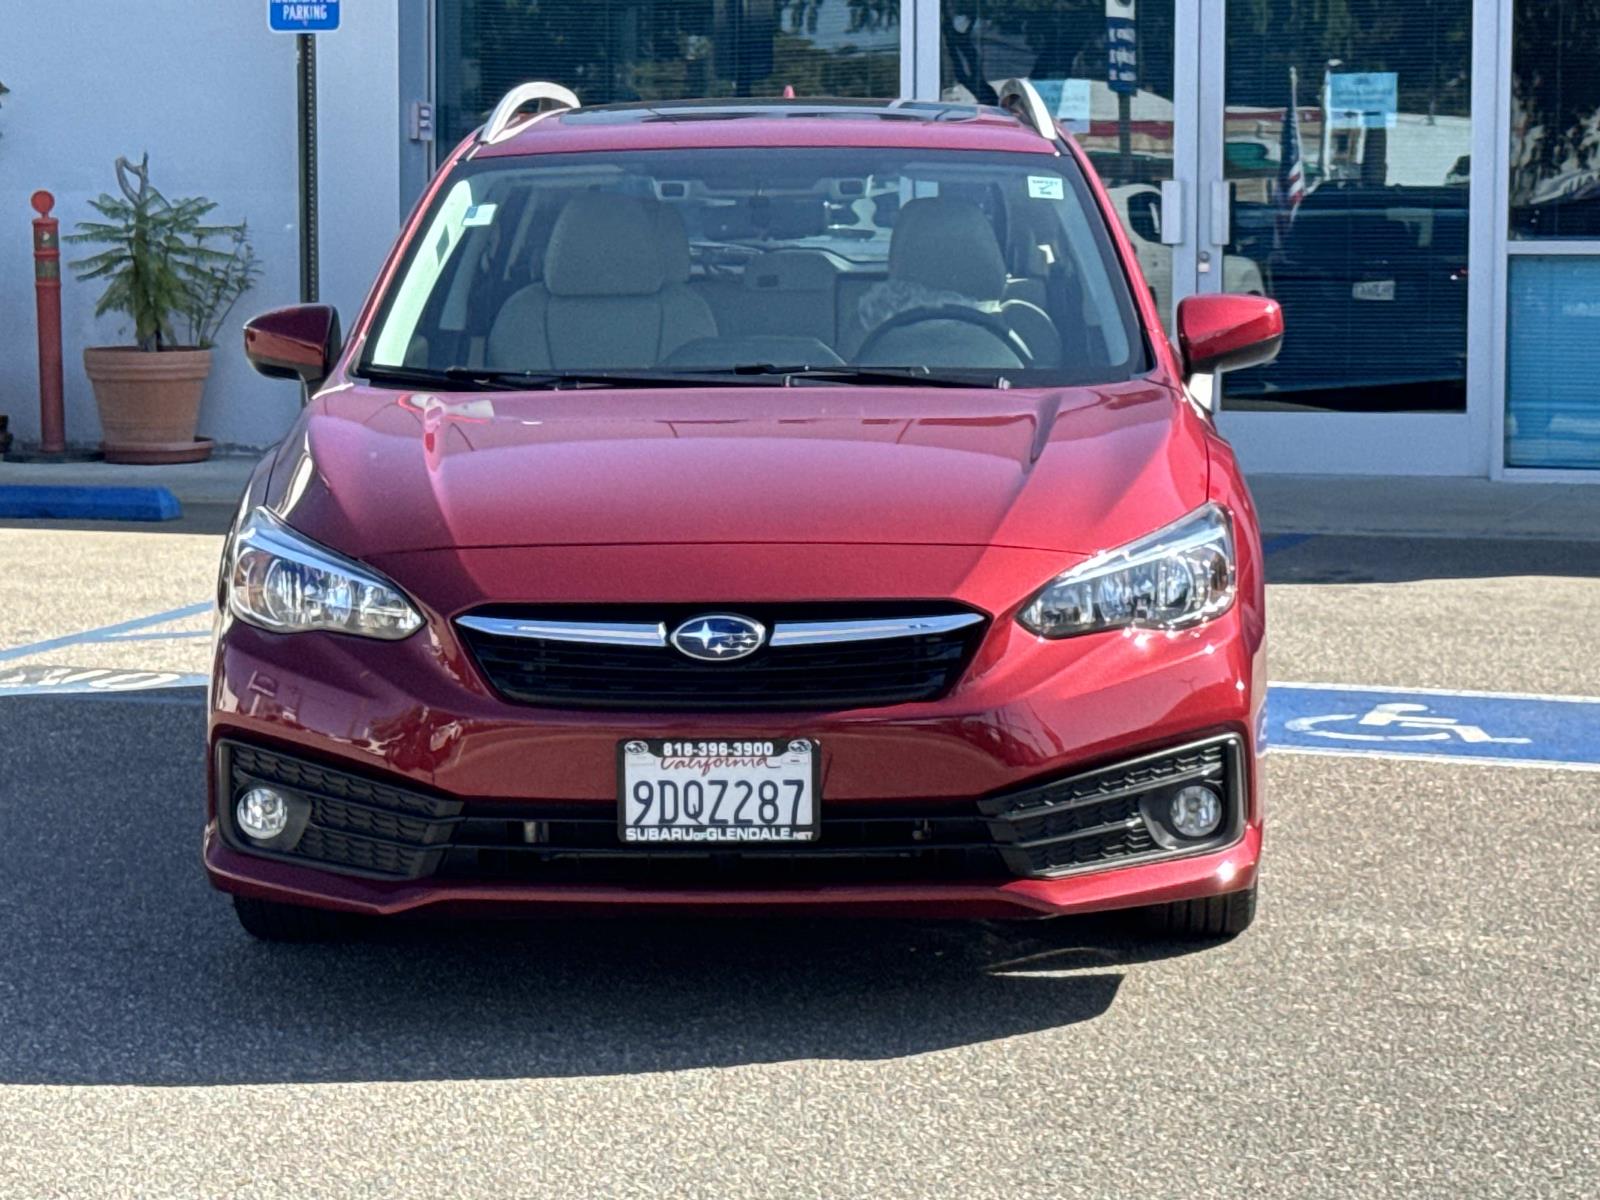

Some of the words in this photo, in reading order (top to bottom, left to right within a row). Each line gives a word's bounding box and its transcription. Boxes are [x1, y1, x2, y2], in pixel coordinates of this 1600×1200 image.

[282, 4, 328, 21] PARKING
[663, 742, 774, 756] 818-396-3900
[660, 756, 781, 777] California
[632, 779, 805, 826] 9DQZ287
